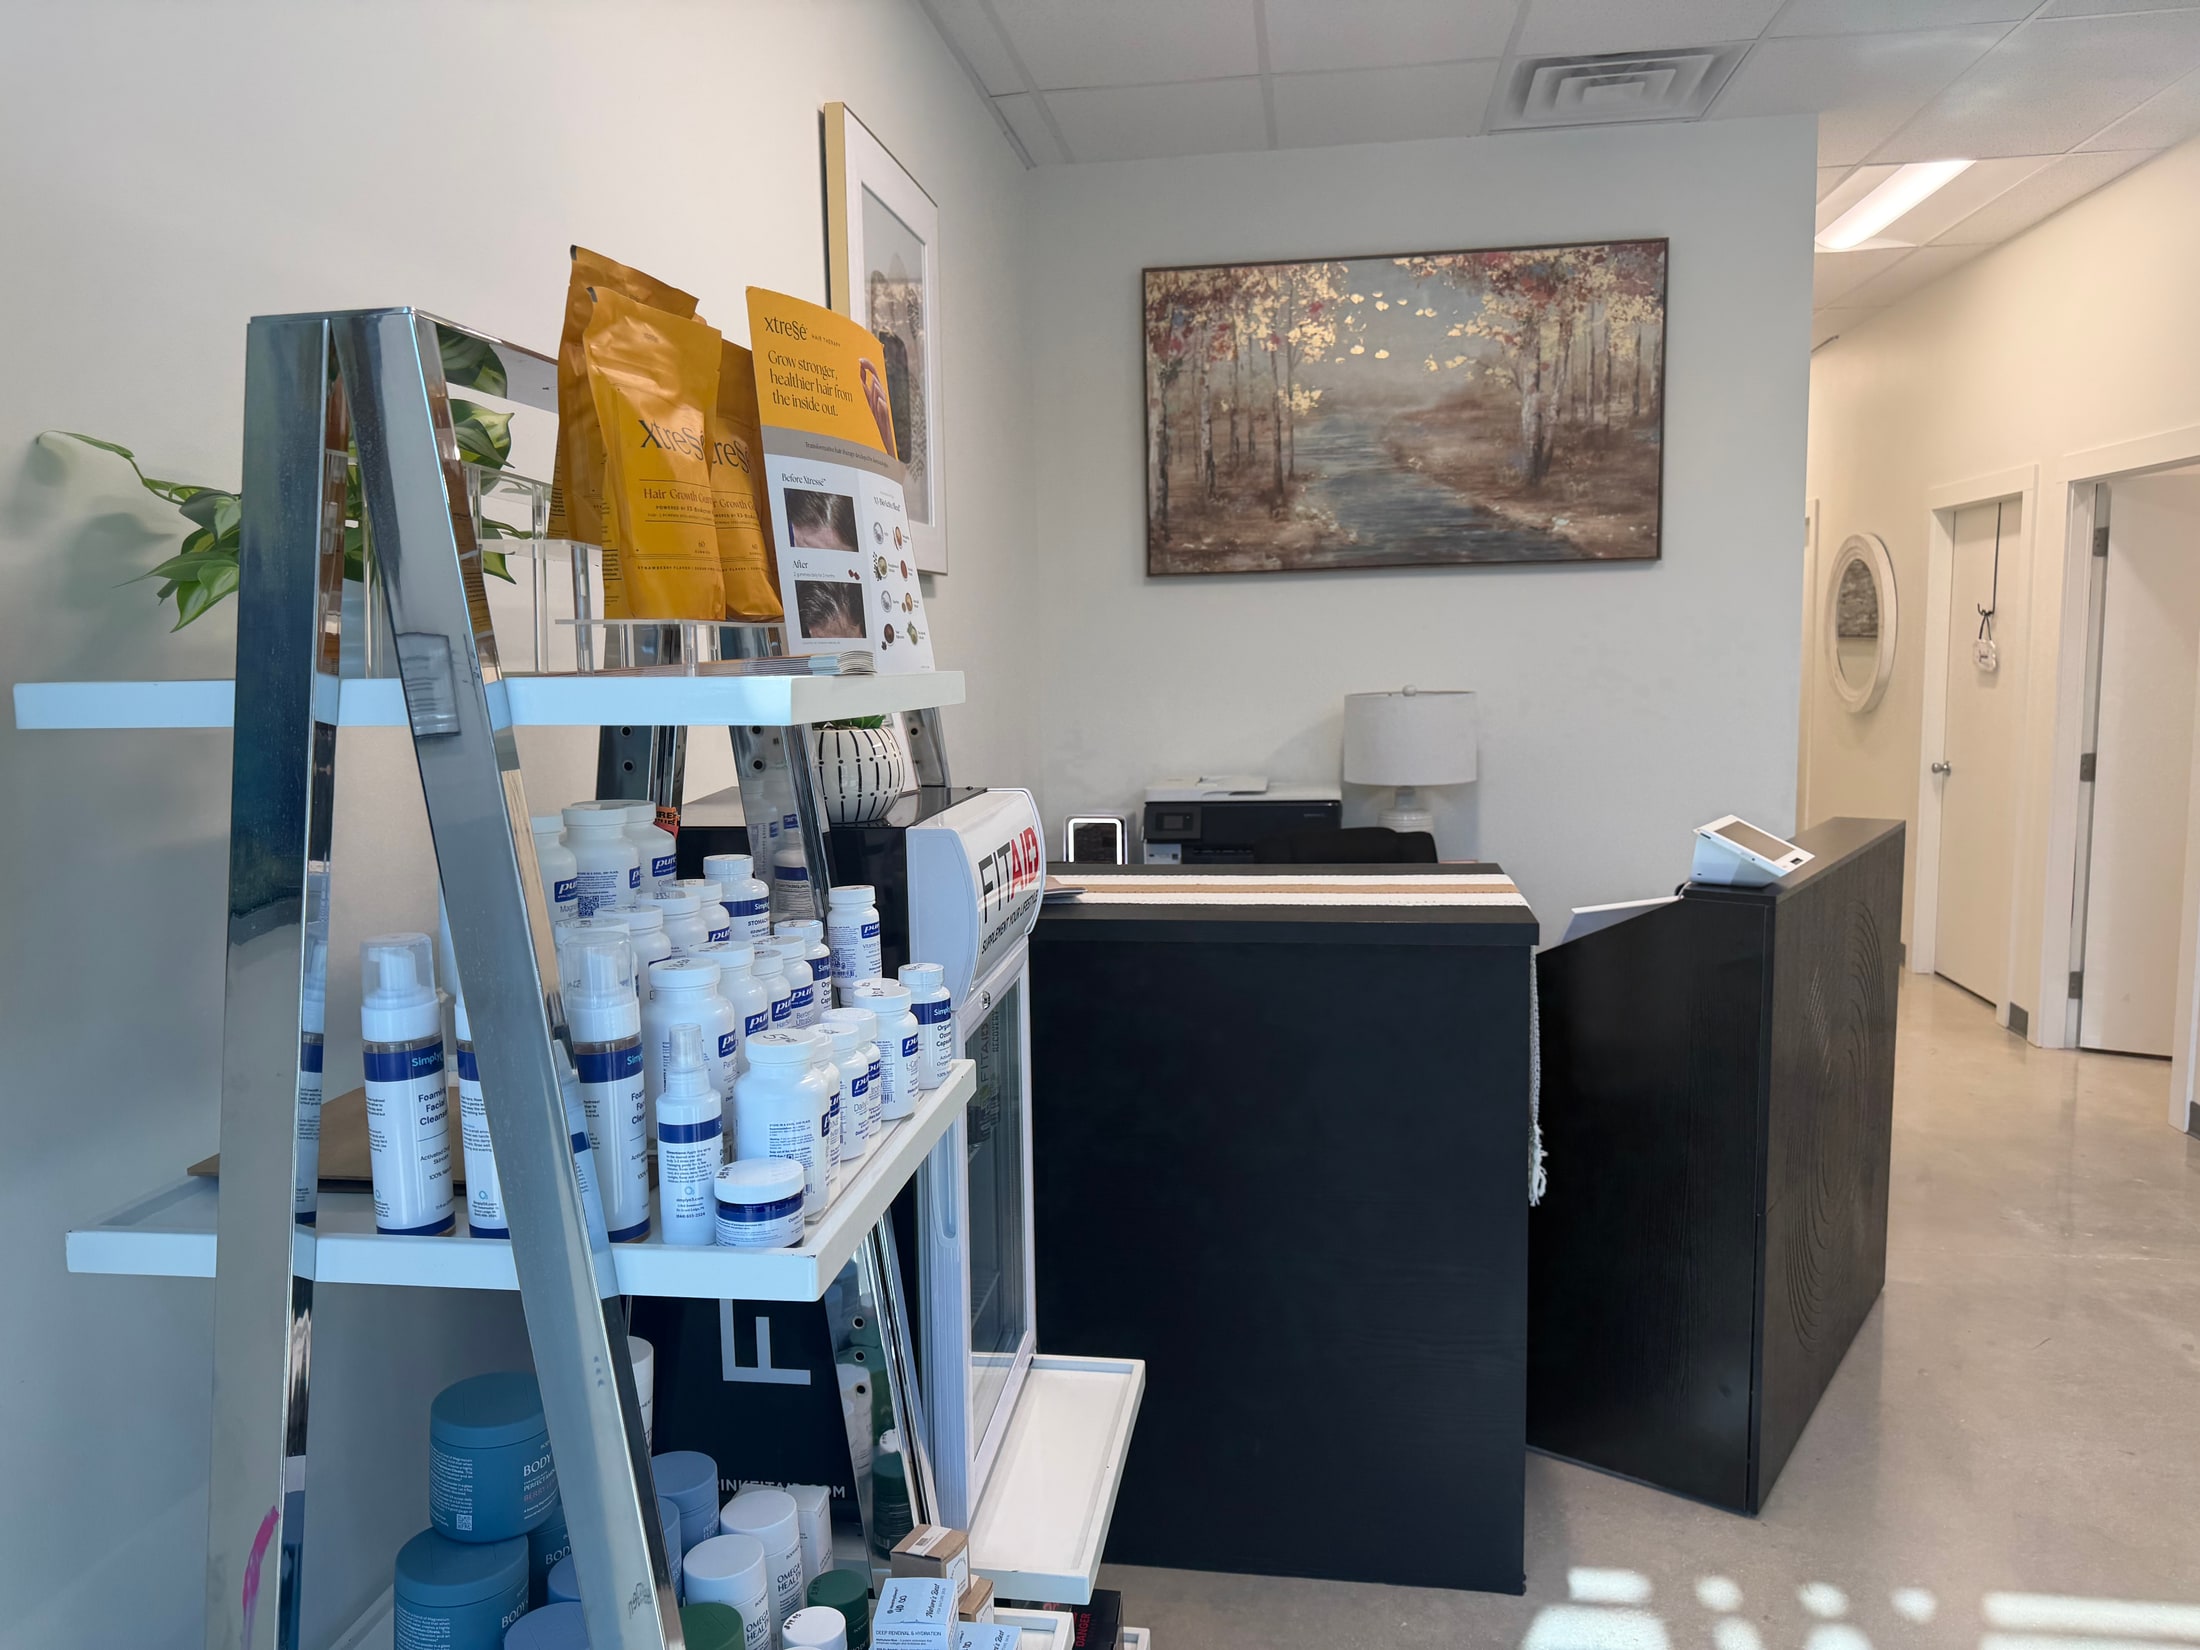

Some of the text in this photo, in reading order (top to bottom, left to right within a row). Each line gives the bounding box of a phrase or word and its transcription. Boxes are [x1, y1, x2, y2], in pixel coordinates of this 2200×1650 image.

[768, 350, 838, 380] Grow stronger,
[769, 368, 853, 402] healthier hair from
[772, 389, 838, 416] the inside out.
[781, 473, 803, 484] Before
[643, 488, 699, 502] Hair Growth
[720, 499, 747, 509] Growth
[793, 560, 808, 569] After
[978, 826, 1040, 924] FITAID
[981, 917, 1010, 955] SUPPLEMENT
[1009, 906, 1021, 927] YOUR
[428, 1171, 442, 1181] 100%
[522, 1454, 552, 1477] BODY
[777, 1562, 800, 1584] OMEGA
[931, 1583, 940, 1596] Best
[745, 1609, 769, 1633] OMEGA
[1075, 1613, 1092, 1647] DANGER
